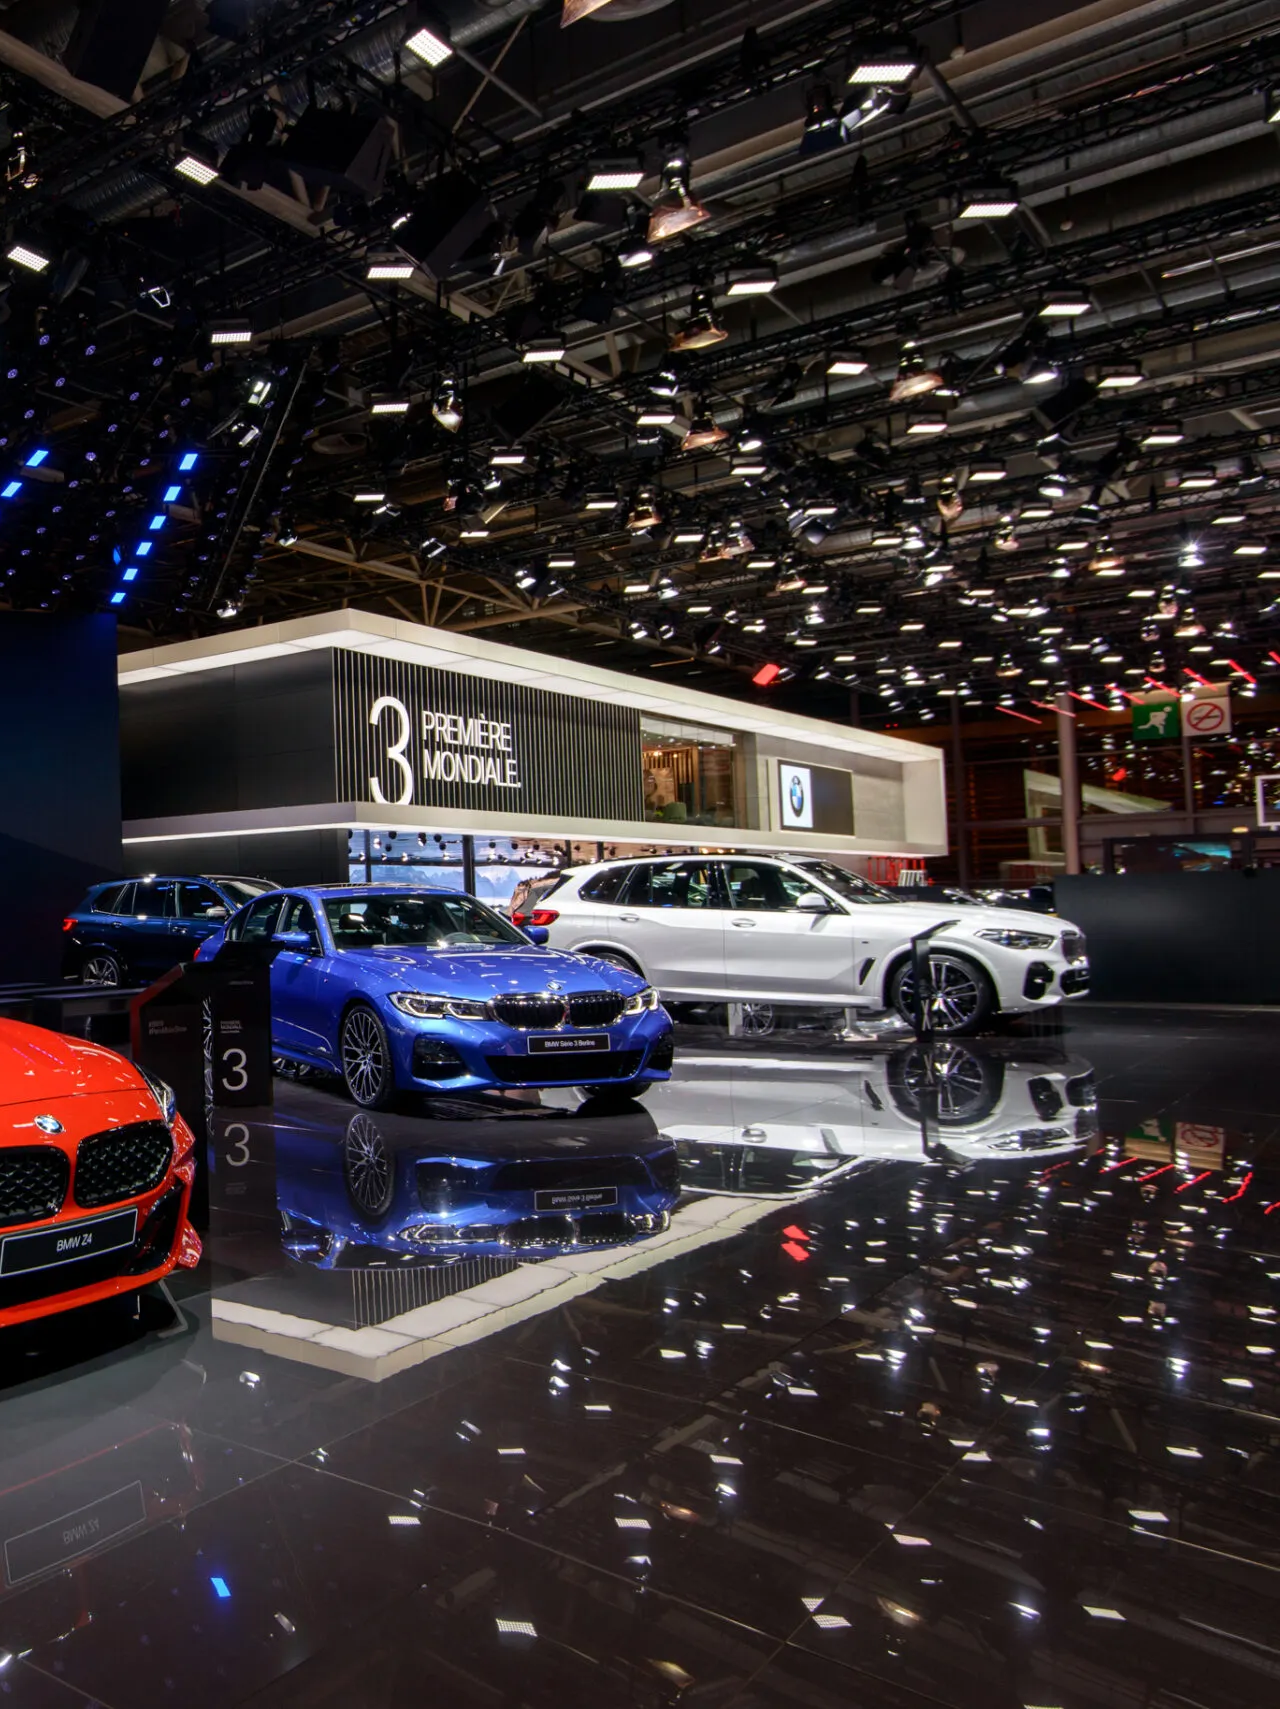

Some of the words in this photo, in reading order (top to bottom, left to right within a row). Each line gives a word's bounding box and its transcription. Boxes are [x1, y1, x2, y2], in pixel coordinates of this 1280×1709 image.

[370, 696, 413, 805] 3
[422, 710, 512, 752] PREMIÈRE
[222, 1048, 248, 1091] 3
[56, 1236, 81, 1253] BMW
[81, 1233, 93, 1247] Z4
